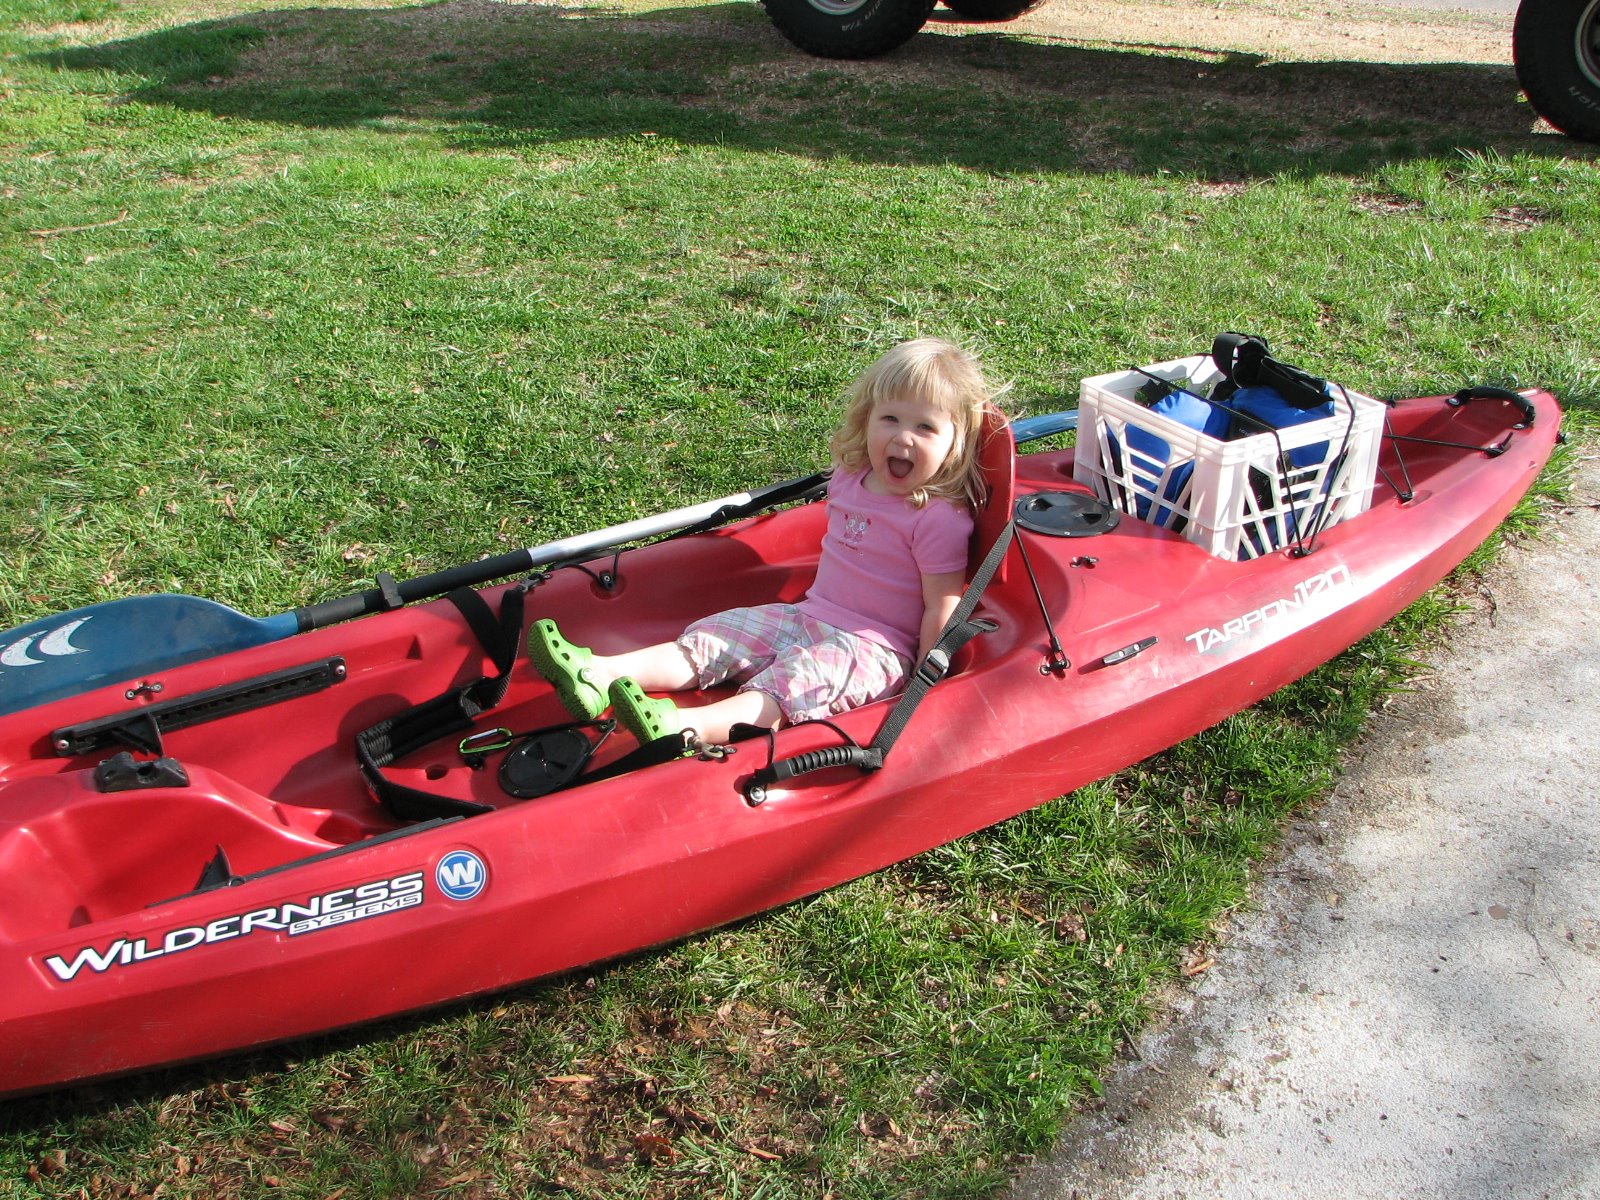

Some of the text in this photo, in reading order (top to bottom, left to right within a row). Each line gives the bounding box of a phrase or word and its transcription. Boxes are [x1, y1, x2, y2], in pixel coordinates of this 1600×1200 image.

[440, 859, 477, 888] W
[45, 872, 424, 981] WILDERNESS
[293, 892, 422, 934] SYSTEMS
